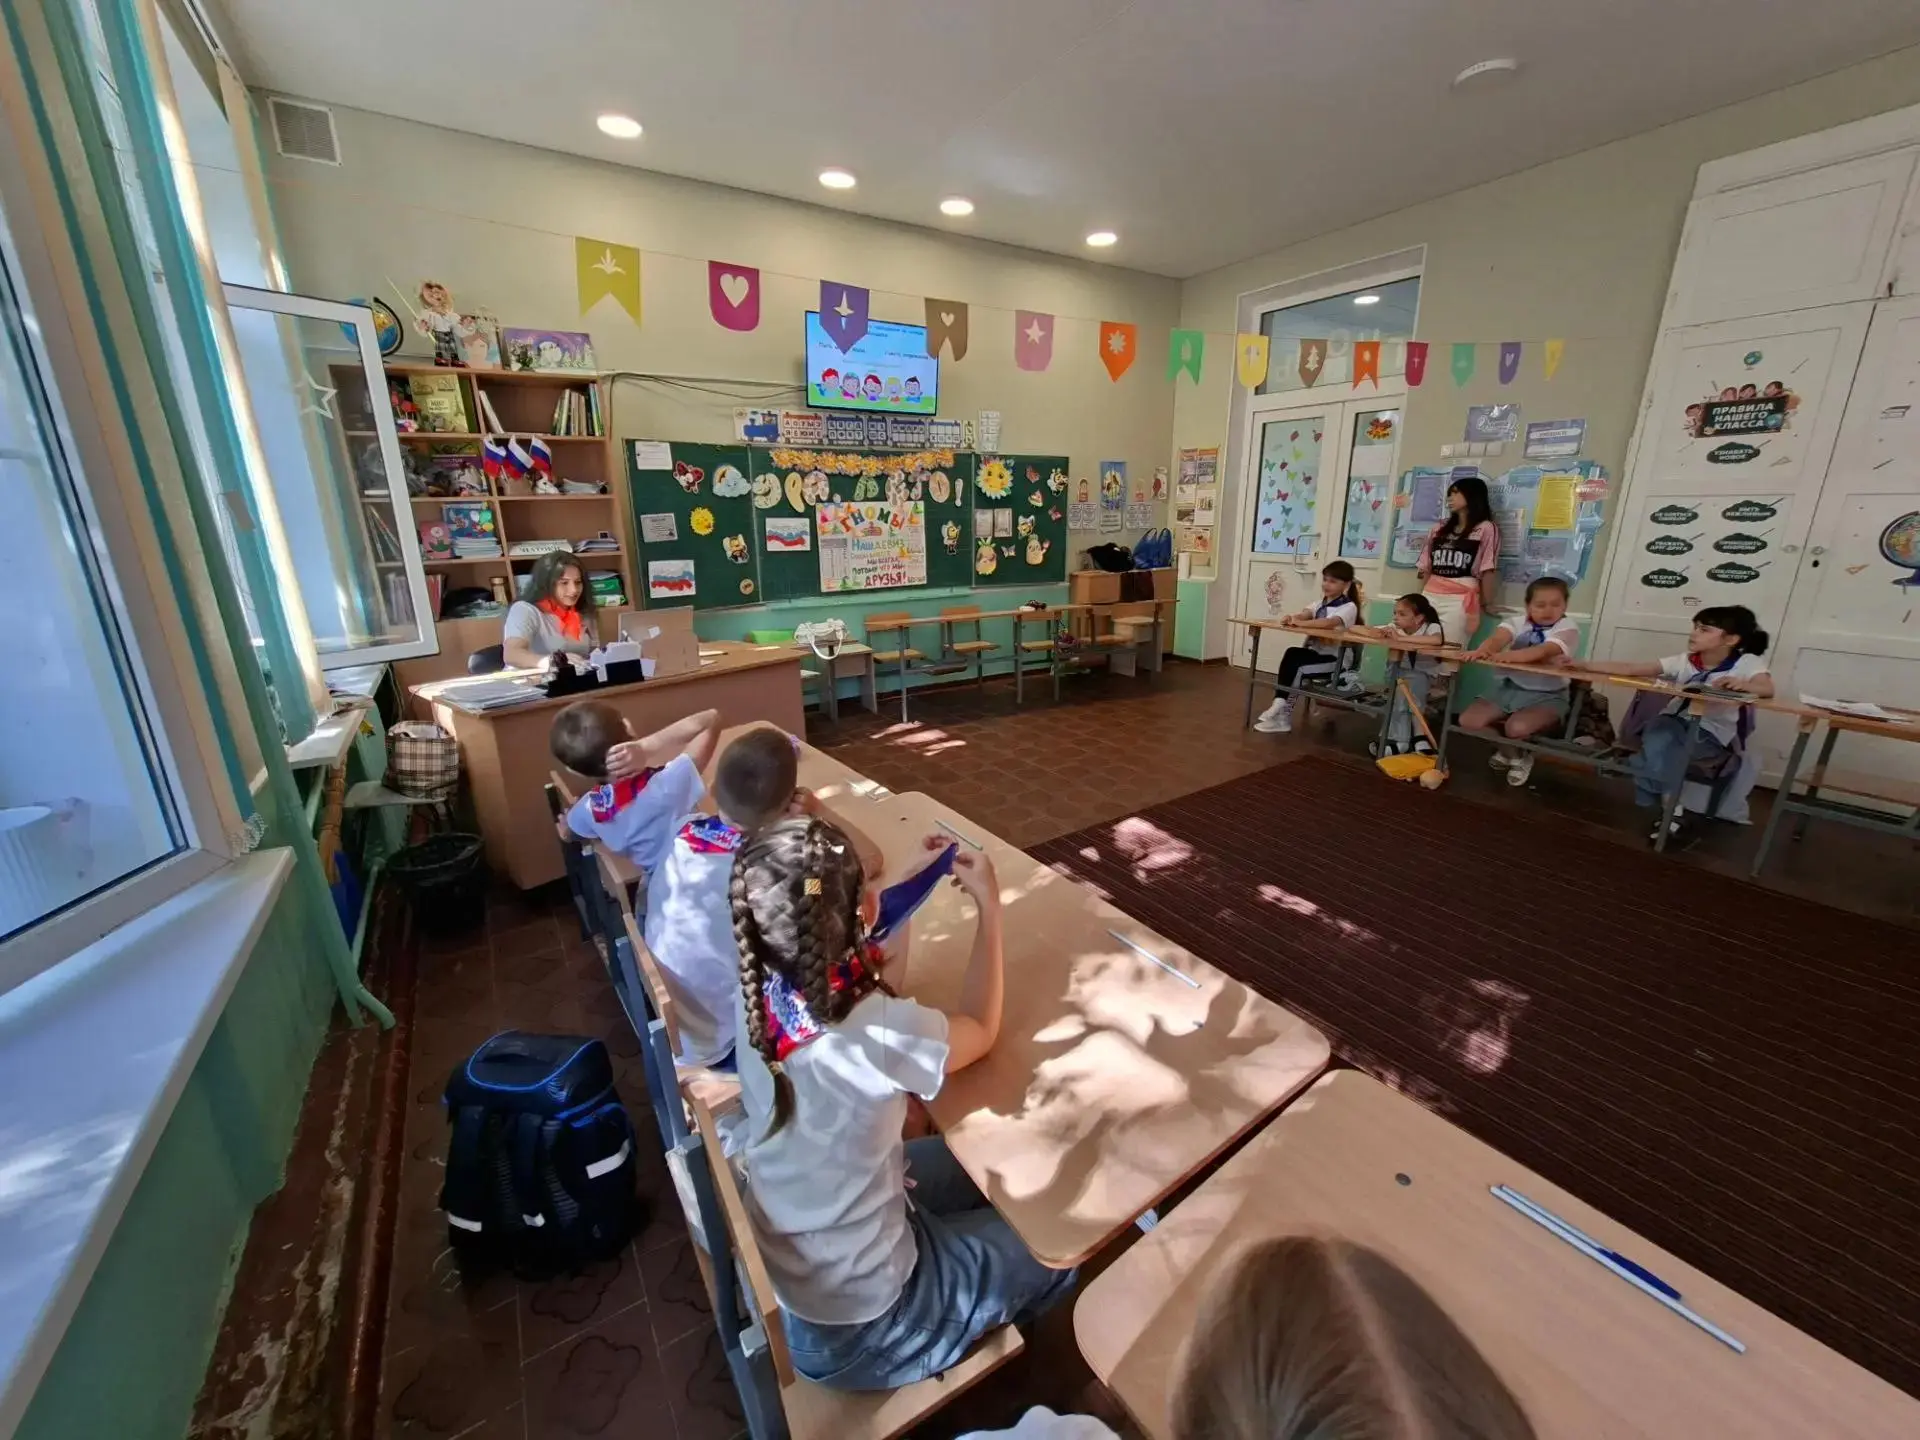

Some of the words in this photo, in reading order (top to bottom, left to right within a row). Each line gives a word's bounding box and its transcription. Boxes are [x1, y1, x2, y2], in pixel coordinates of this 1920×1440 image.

[1712, 402, 1774, 415] ПРАВИЛА
[1714, 411, 1768, 423] НАШЕГО
[1713, 420, 1764, 430] КЛАССА
[840, 504, 905, 532] ГНОМЫ
[1432, 549, 1472, 568] ALLOP
[864, 571, 907, 587] ДРУЗЬЯ!
